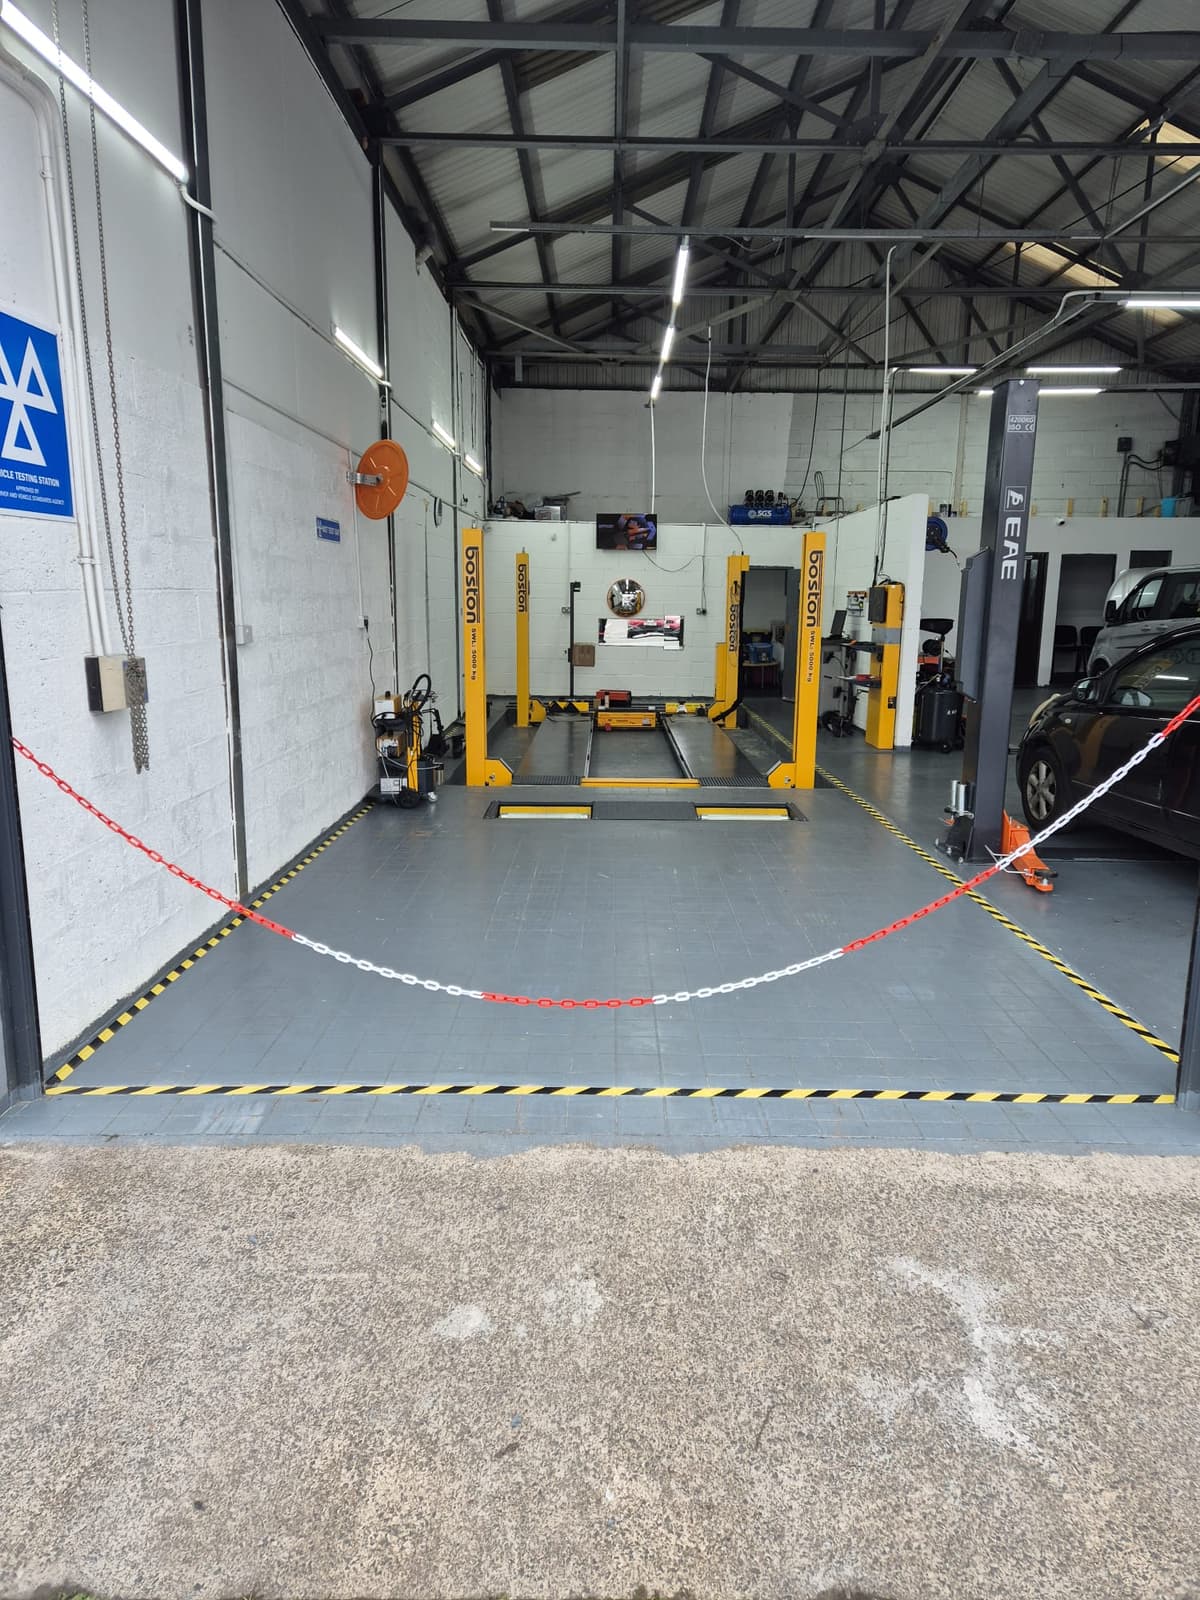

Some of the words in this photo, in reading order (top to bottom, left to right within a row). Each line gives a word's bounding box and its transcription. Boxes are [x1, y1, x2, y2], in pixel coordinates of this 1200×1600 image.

[15, 472, 38, 483] TESTING
[39, 476, 60, 488] STATION
[757, 509, 773, 517] SGS
[1001, 517, 1022, 580] EAE
[465, 546, 480, 624] boston
[518, 564, 527, 613] boston
[806, 550, 823, 628] boston
